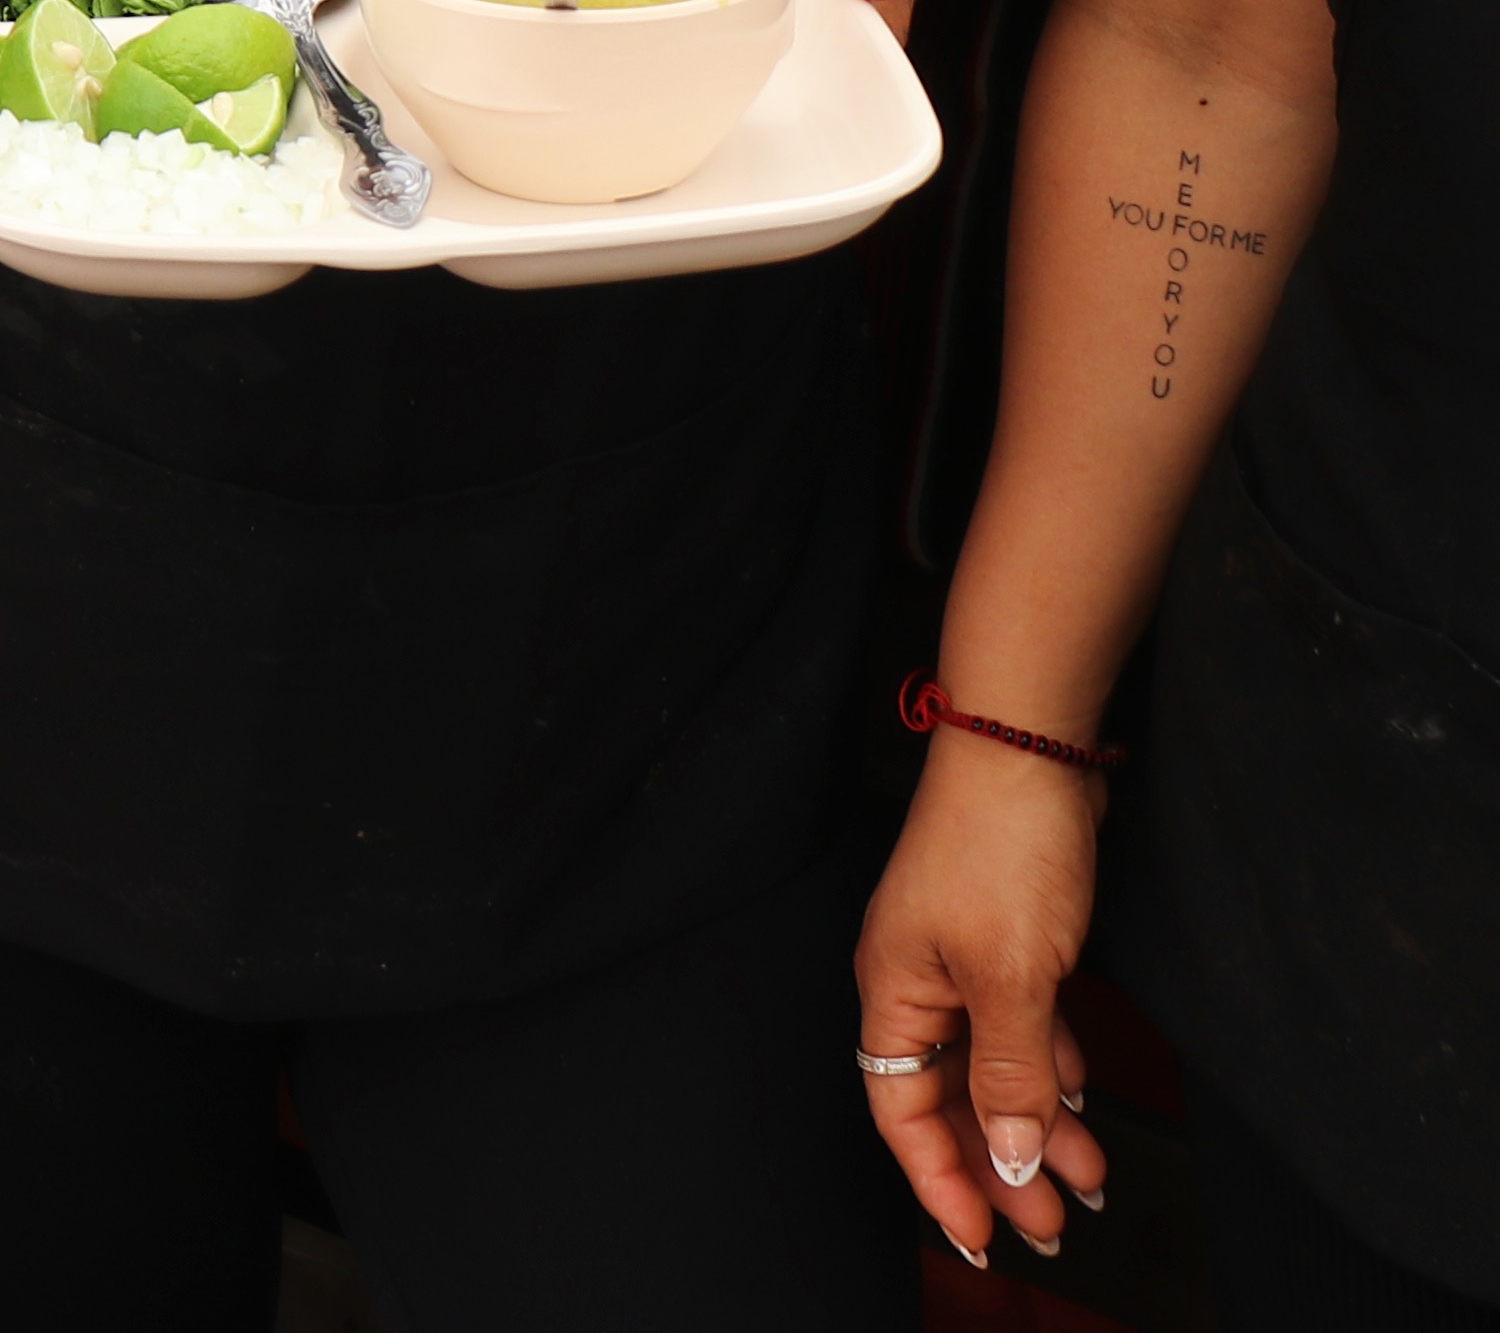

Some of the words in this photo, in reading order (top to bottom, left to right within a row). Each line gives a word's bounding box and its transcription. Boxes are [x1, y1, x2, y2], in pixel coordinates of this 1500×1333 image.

[1107, 196, 1165, 232] YOU
[1171, 213, 1226, 247] FOR
[1229, 229, 1268, 256] ME
